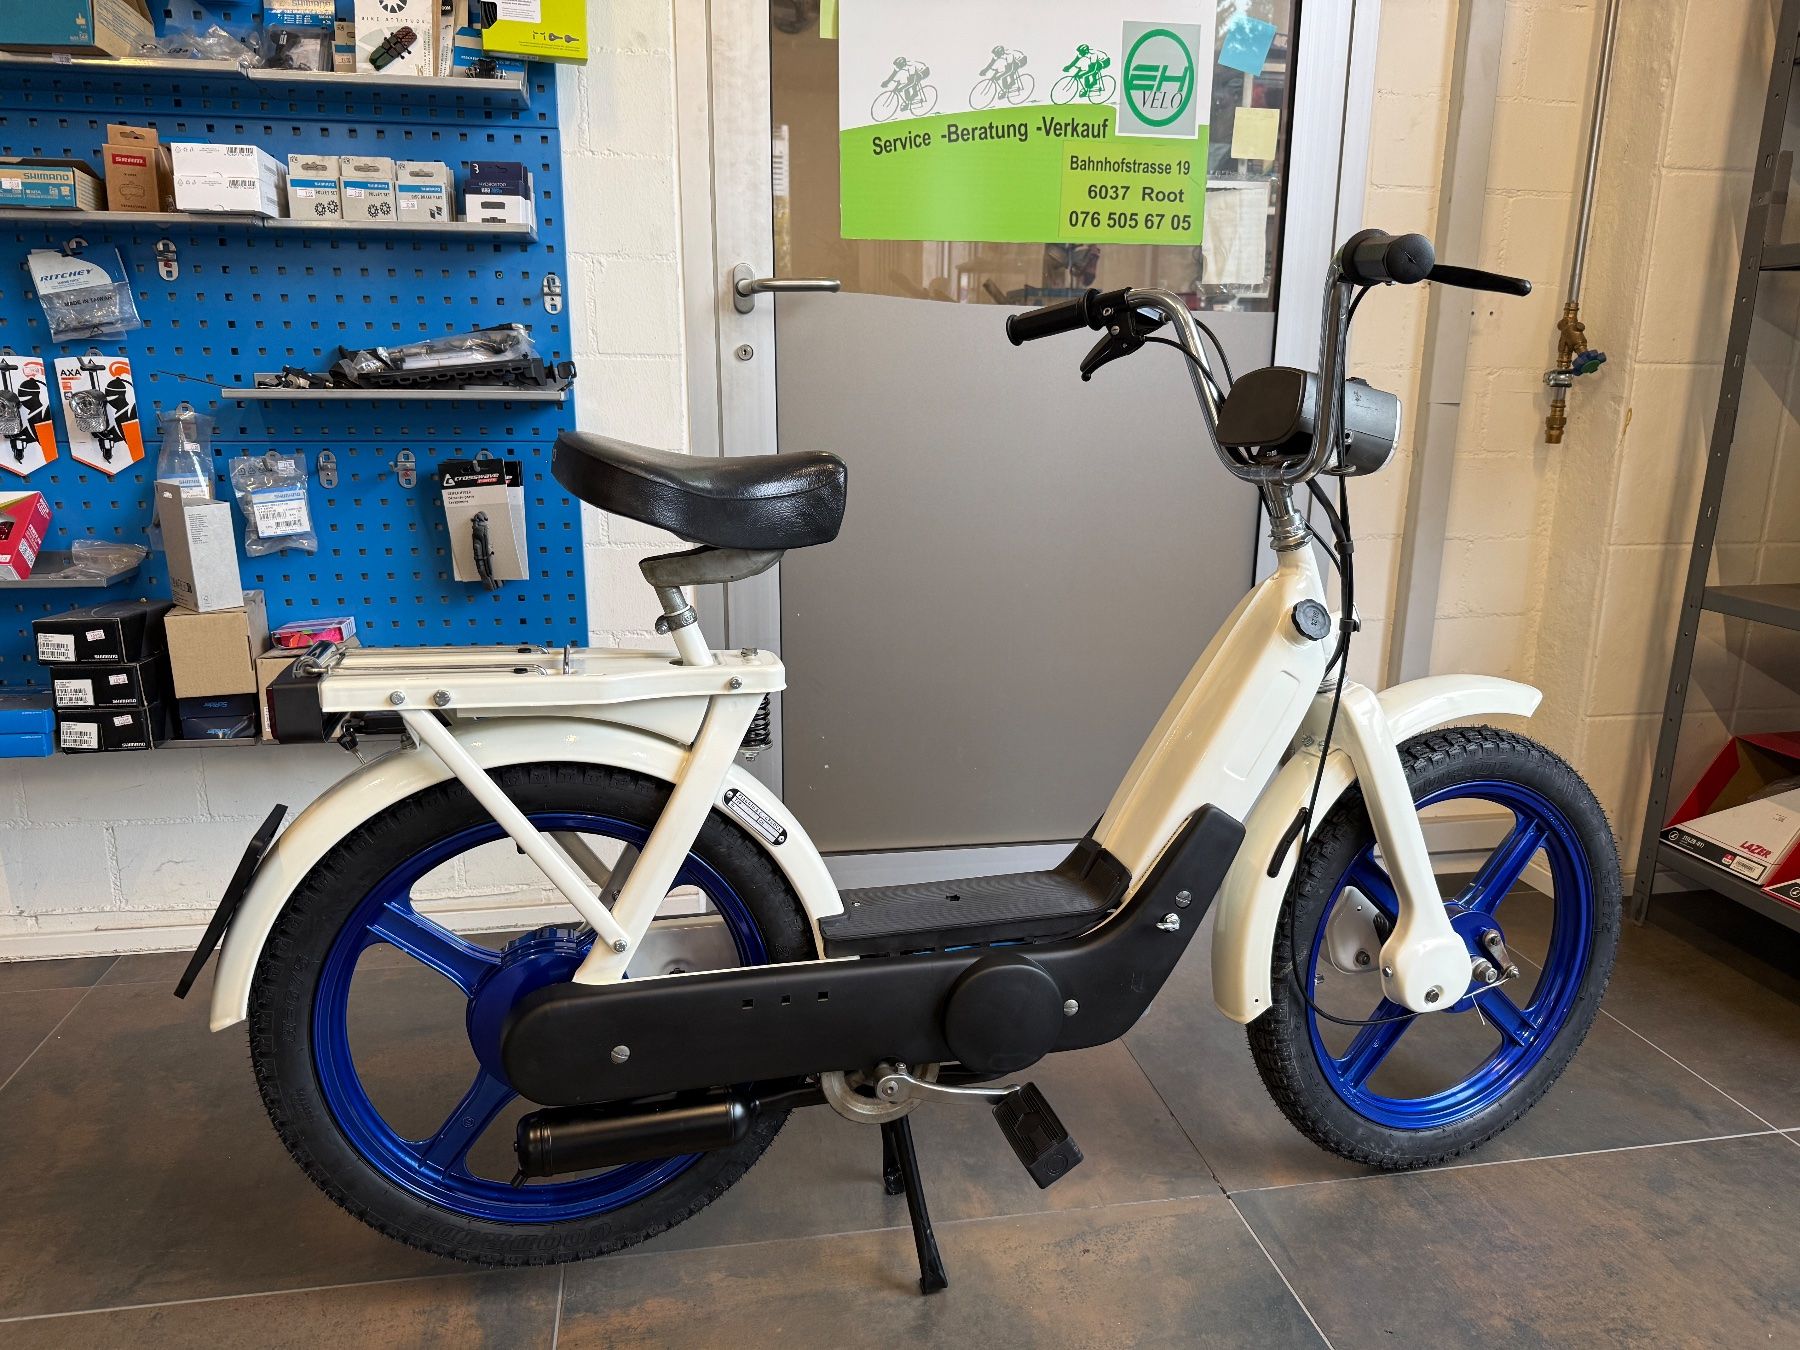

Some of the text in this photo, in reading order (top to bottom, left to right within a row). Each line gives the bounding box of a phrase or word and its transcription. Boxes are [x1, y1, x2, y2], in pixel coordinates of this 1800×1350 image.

[1142, 90, 1183, 109] VELO
[872, 116, 1108, 156] Service -Beratung -Verkauf
[1070, 155, 1190, 176] Bahnhofstrasse 19
[23, 173, 70, 181] SHIMANO
[1087, 184, 1184, 203] 6037 Root
[1069, 211, 1192, 231] 076 505 67 05
[40, 268, 93, 282] RITCHEY
[64, 298, 82, 307] MADE
[60, 368, 82, 377] AXA
[1740, 841, 1772, 858] LAZER
